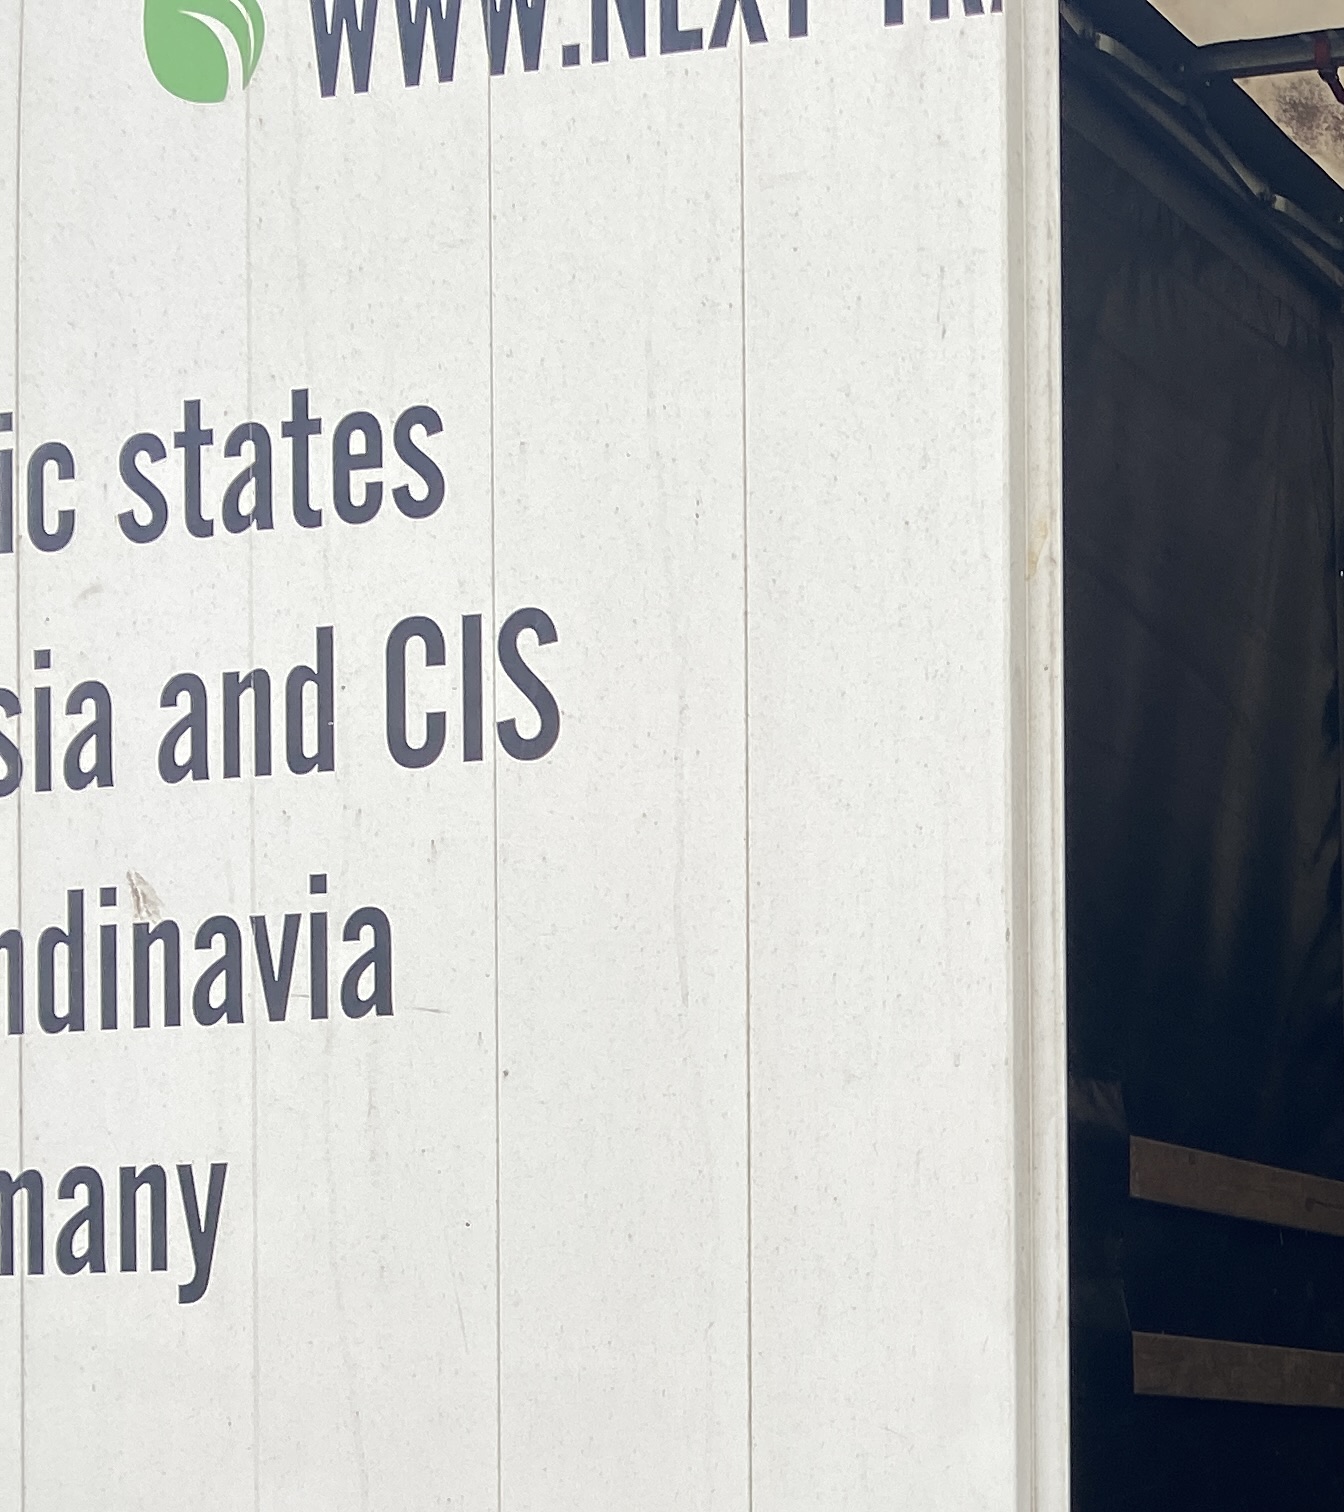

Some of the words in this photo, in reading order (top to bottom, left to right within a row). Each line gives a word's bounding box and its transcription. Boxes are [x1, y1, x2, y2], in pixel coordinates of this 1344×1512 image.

[0, 411, 76, 554] ic
[117, 388, 445, 544] states
[158, 625, 335, 784] and
[385, 607, 560, 769] CIS
